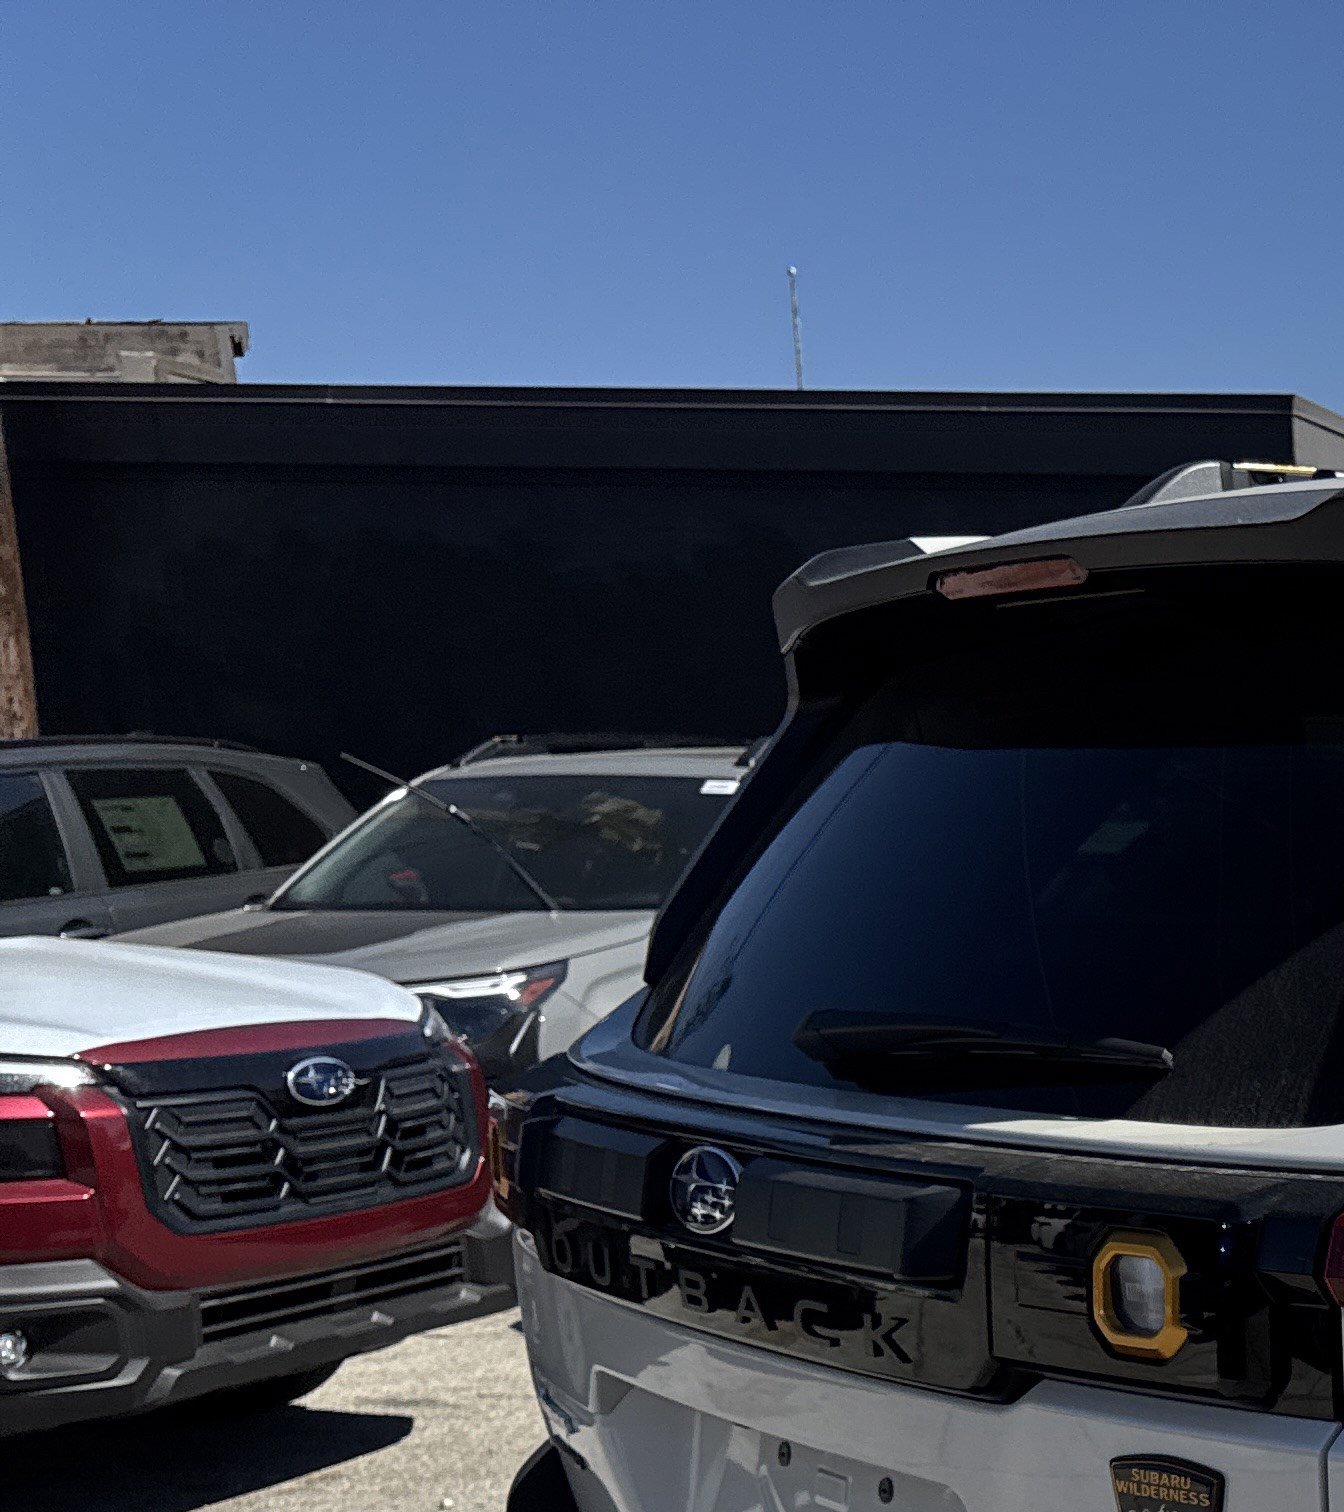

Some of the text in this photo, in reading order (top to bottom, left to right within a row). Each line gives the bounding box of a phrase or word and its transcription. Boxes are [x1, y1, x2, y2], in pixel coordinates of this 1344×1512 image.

[551, 1218, 914, 1364] OUTBACK
[1131, 1468, 1191, 1489] SUBARU
[1115, 1480, 1211, 1507] WILDERNESS
